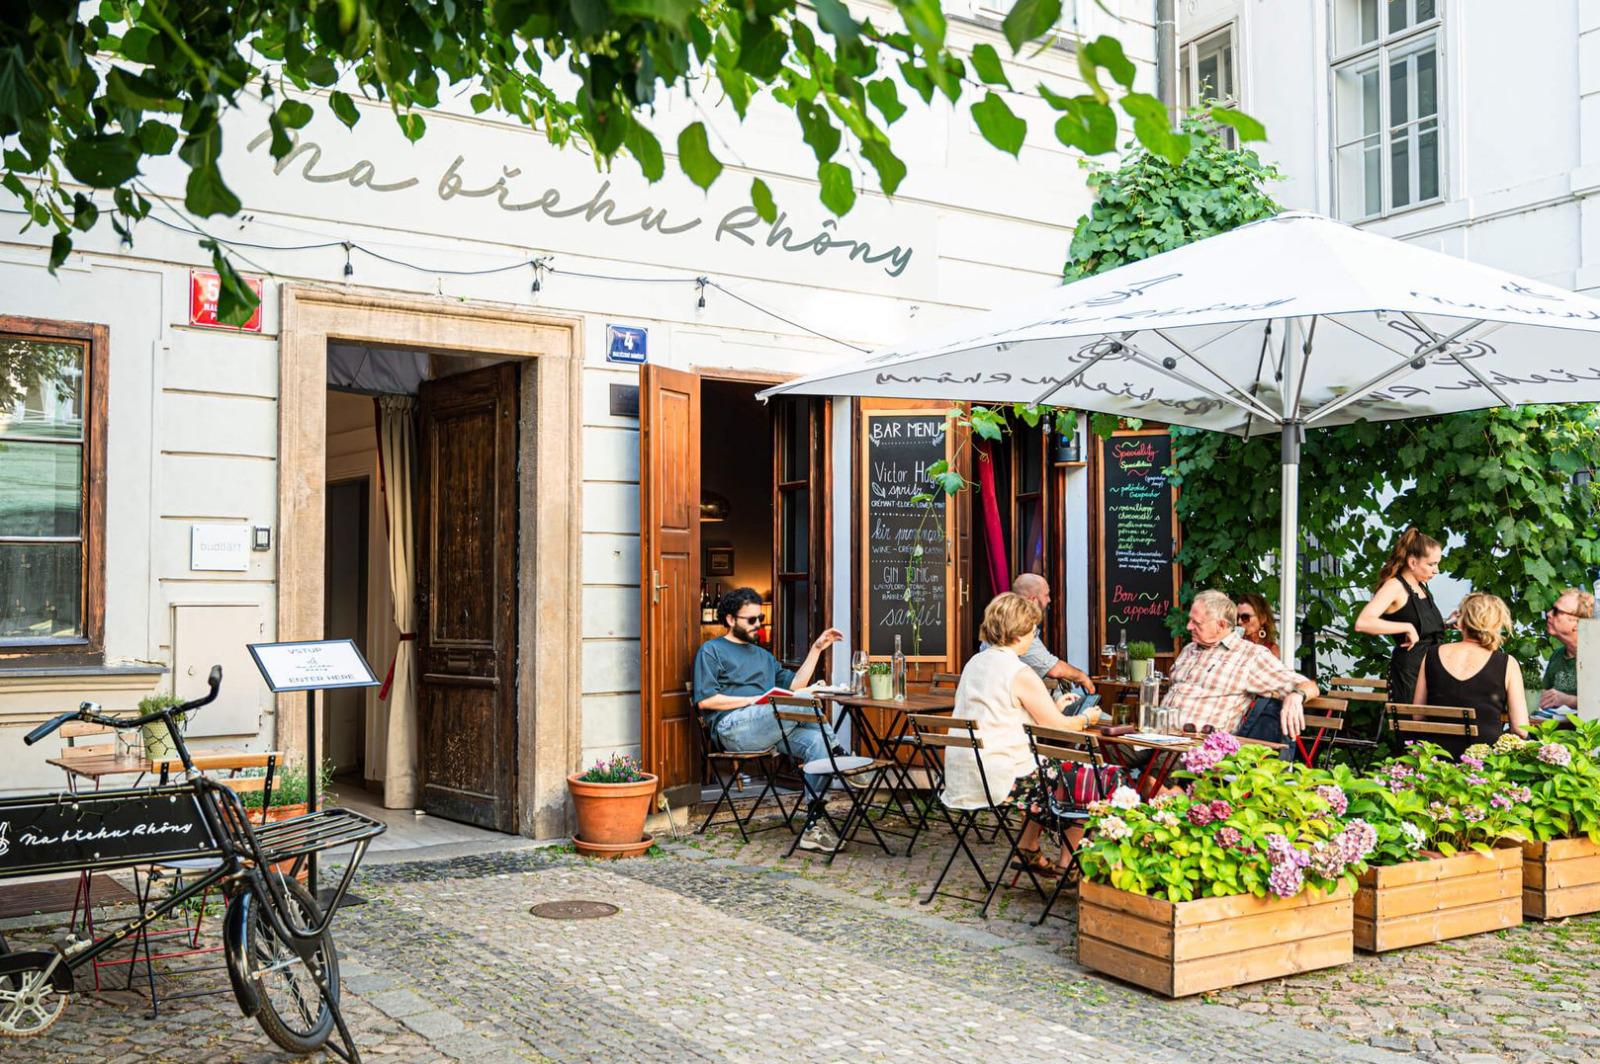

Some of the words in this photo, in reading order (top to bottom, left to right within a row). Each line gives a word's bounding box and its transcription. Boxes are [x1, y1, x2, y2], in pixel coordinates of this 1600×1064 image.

[438, 155, 703, 235] břehu
[715, 205, 913, 277] Rhôny
[623, 331, 634, 350] 4
[873, 422, 902, 438] BAR
[907, 421, 941, 437] MENU
[874, 460, 908, 483] Victor
[914, 460, 937, 489] Hug
[871, 517, 891, 540] kir
[883, 566, 899, 584] GIN
[1112, 584, 1138, 603] Bon
[289, 675, 324, 683] ENTER
[327, 673, 355, 681] HERE
[132, 822, 193, 836] Rhôny
